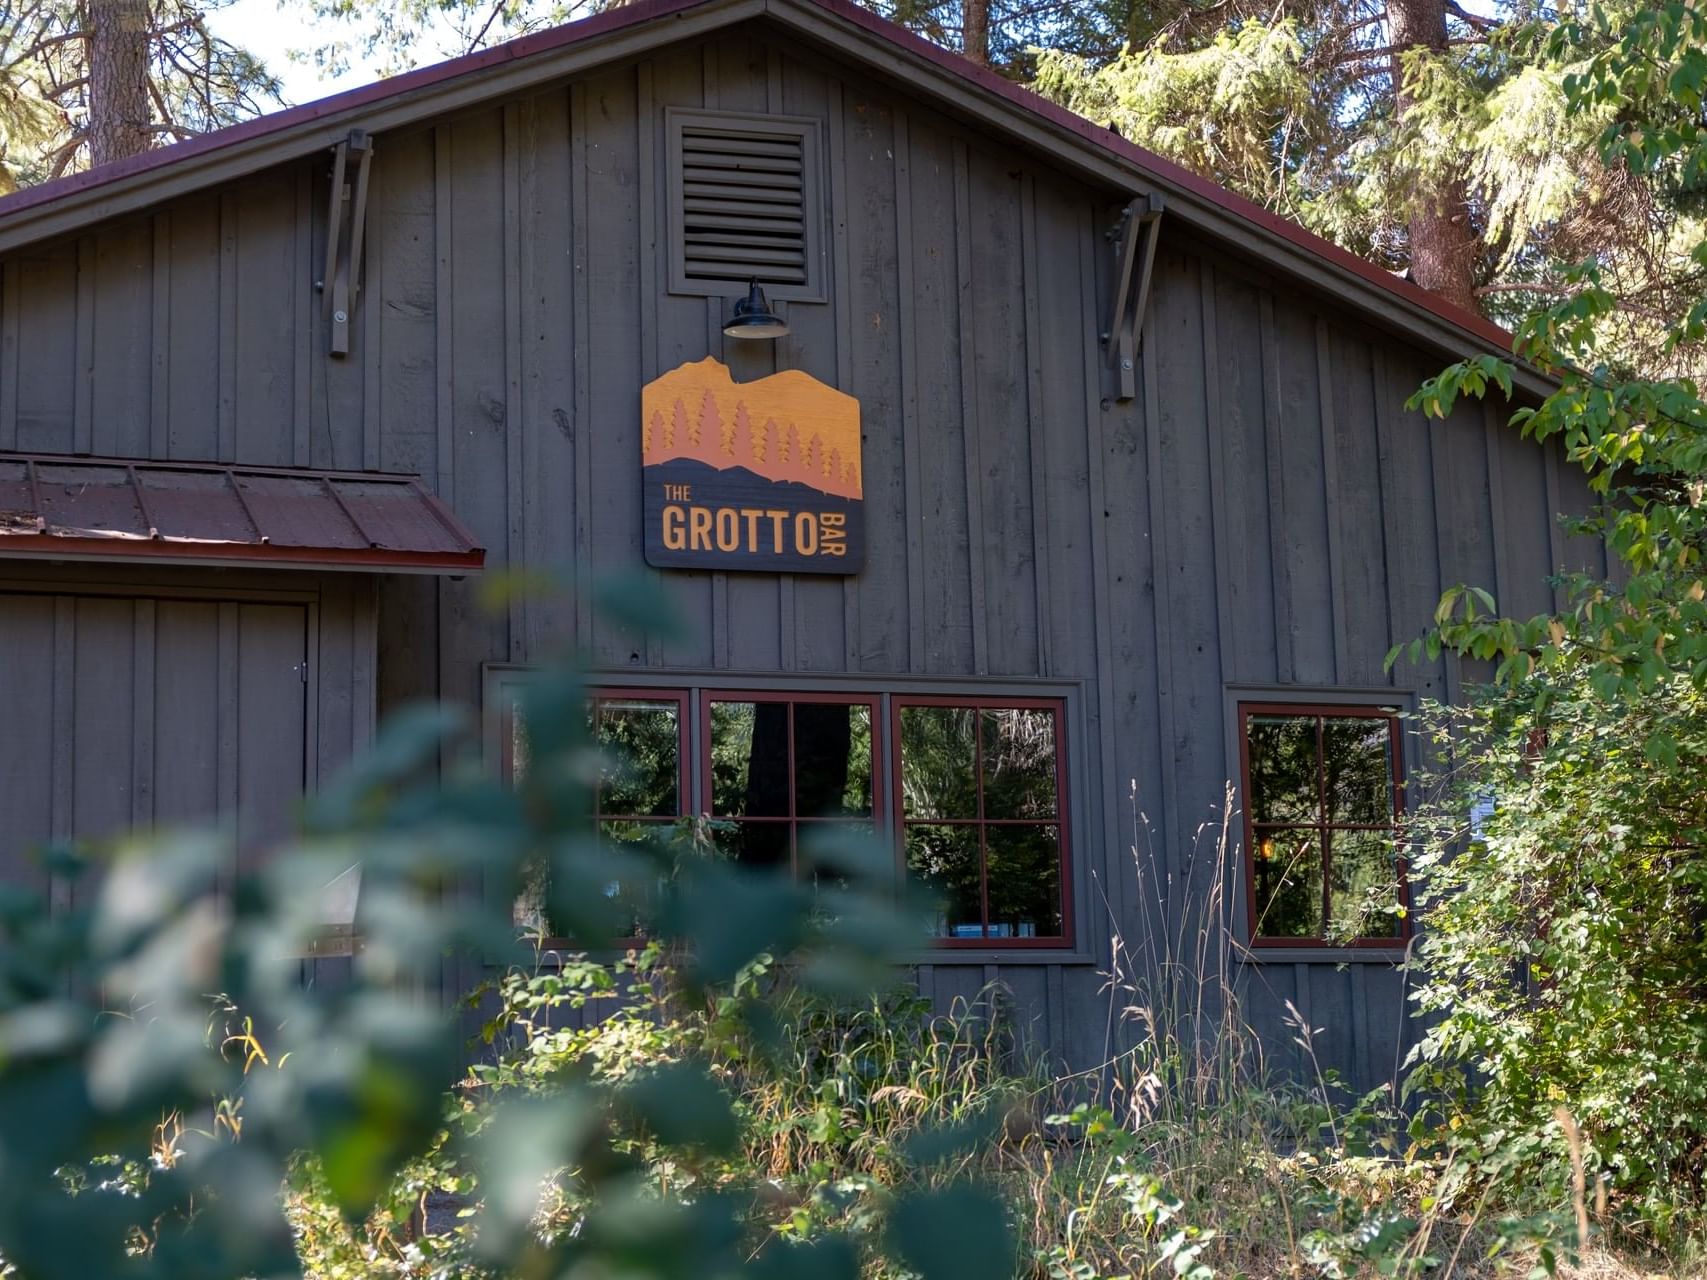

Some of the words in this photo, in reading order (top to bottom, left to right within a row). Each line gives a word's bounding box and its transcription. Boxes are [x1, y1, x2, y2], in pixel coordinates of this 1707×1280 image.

[664, 484, 691, 501] THE
[662, 505, 818, 556] GROTTO
[820, 512, 846, 556] BAR
